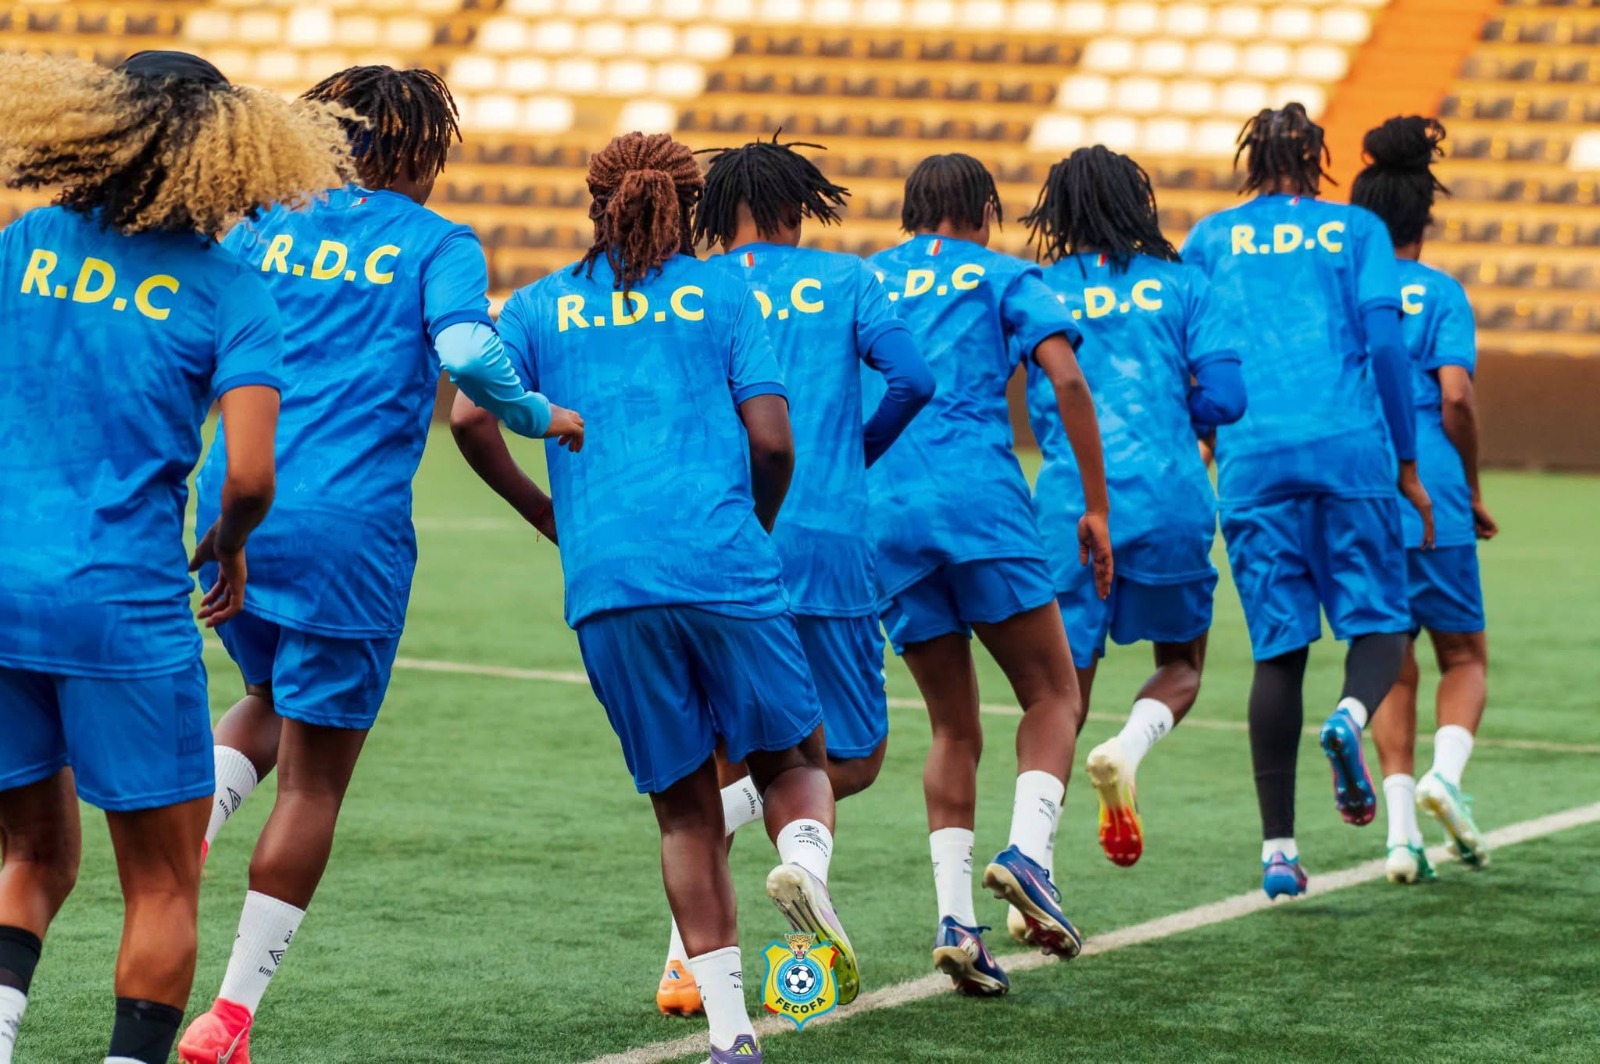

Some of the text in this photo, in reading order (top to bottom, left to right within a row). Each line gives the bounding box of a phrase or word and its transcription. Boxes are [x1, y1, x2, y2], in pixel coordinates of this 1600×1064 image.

[1231, 221, 1345, 255] R.D.C
[261, 234, 401, 285] R.D.C
[20, 248, 179, 320] R.D.C
[874, 263, 985, 302] .D.C
[1056, 279, 1163, 320] .D.C
[557, 285, 704, 332] R.D.C
[742, 787, 756, 815] umbro
